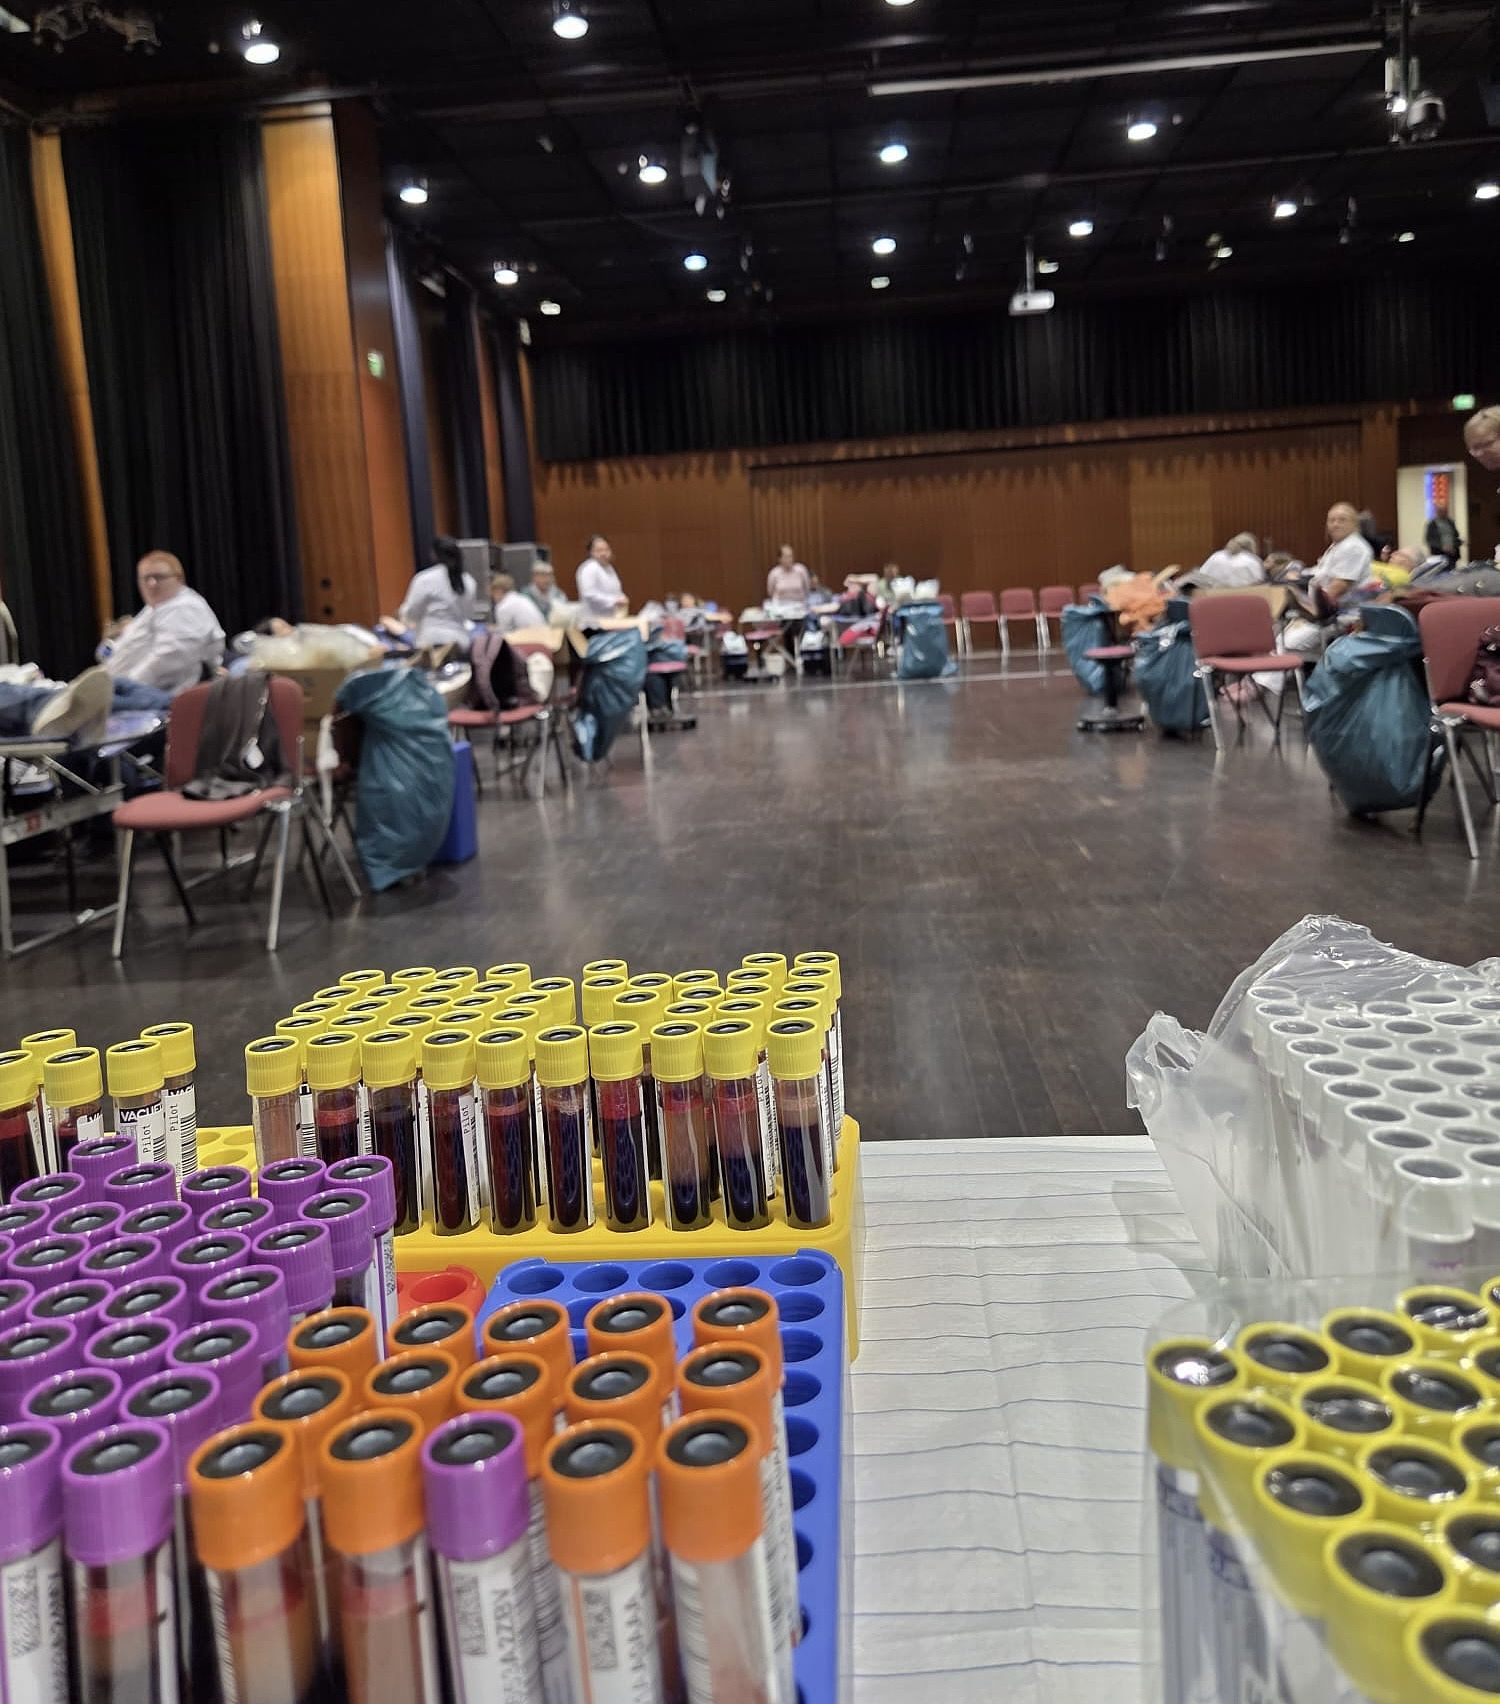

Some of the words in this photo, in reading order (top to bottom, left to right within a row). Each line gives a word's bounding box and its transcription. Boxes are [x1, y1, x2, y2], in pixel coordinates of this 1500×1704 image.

[169, 1104, 178, 1131] Pilot
[461, 1105, 469, 1134] Pilot
[142, 1124, 151, 1153] Pilot
